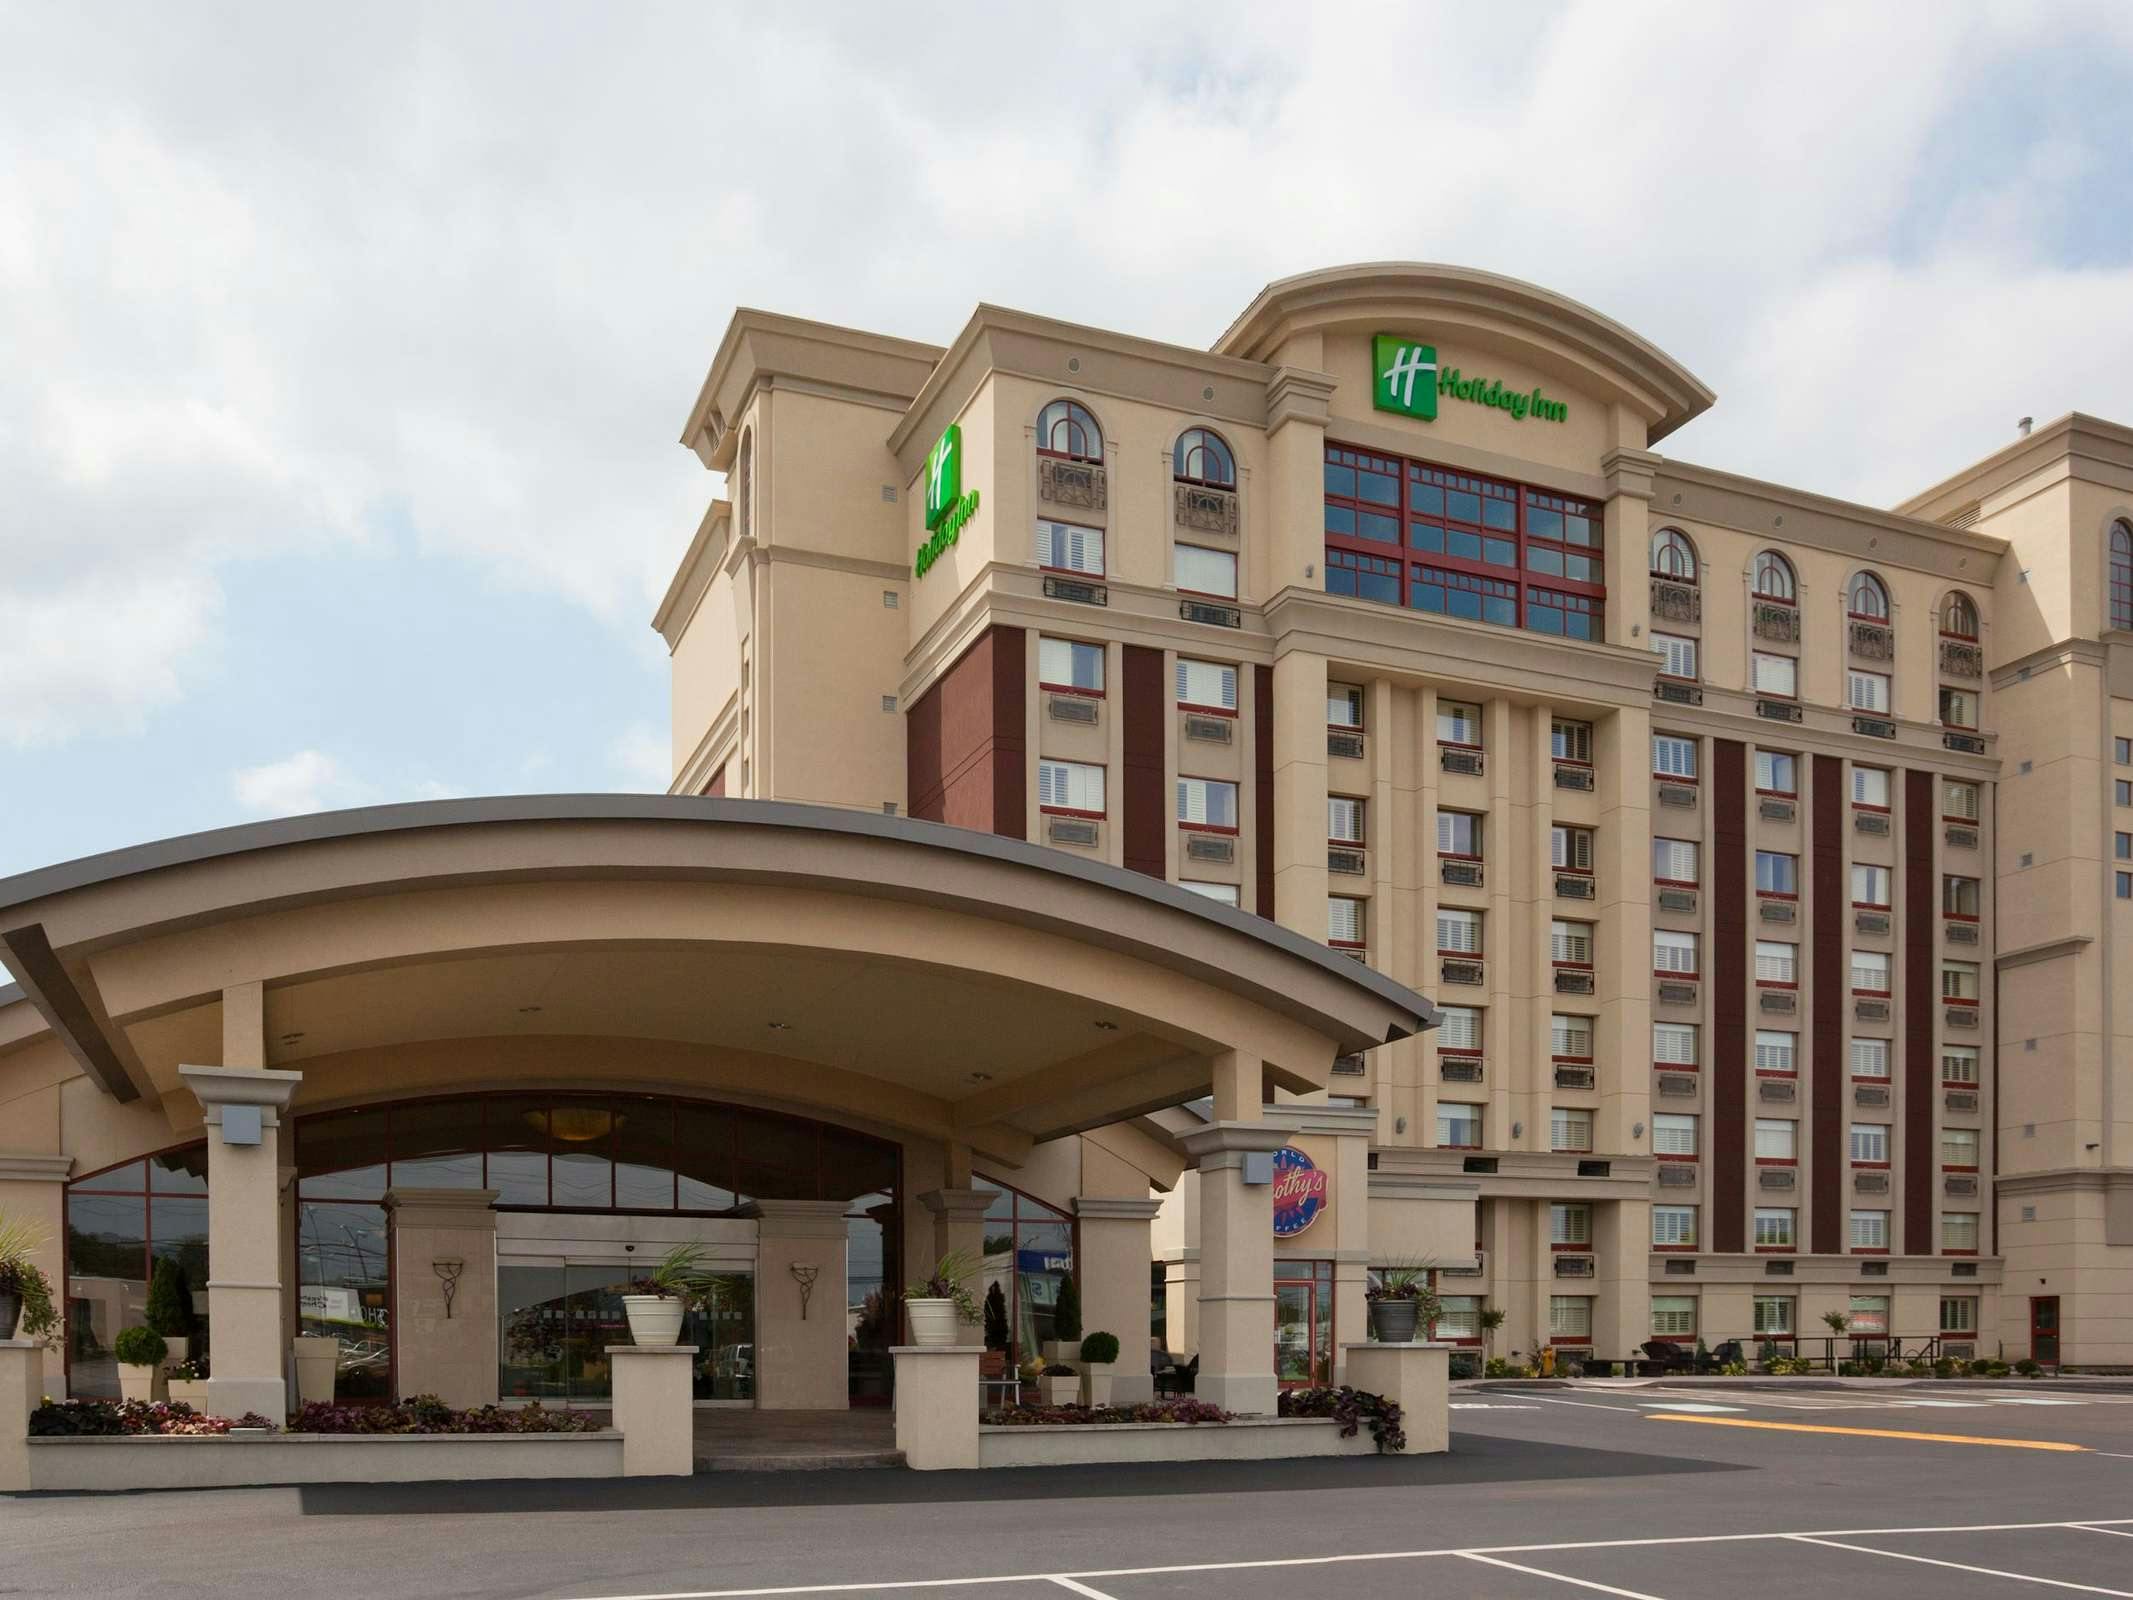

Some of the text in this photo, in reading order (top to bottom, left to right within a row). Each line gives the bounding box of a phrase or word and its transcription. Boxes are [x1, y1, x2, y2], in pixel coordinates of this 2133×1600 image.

[1438, 366, 1568, 423] Holiday Inn
[1273, 1149, 1305, 1162] ORLD
[1273, 1165, 1323, 1206] othy's
[1275, 1217, 1306, 1231] FFEE
